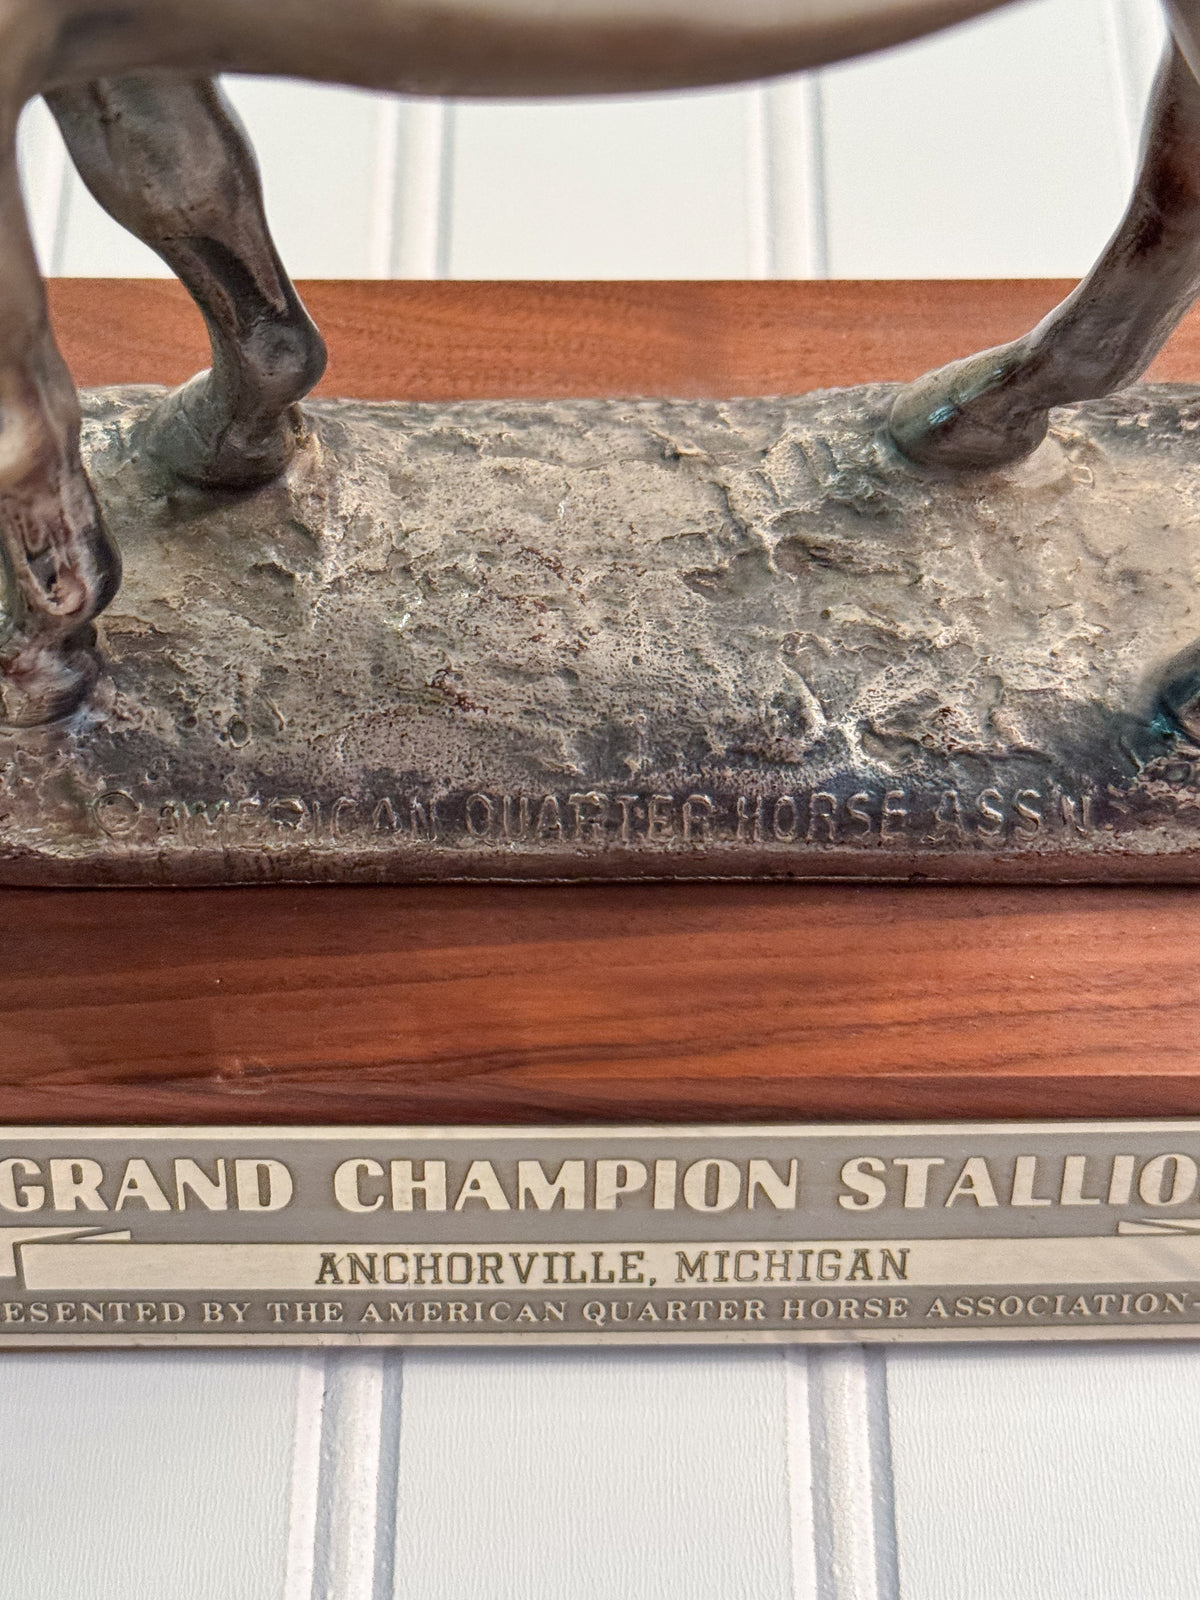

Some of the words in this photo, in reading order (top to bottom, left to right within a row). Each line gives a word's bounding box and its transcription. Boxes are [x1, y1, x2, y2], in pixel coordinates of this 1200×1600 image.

[736, 790, 906, 845] HORSE
[0, 1157, 293, 1213] GRAND
[333, 1158, 798, 1213] CHAMPION
[837, 1153, 1199, 1211] STALLIO
[315, 1250, 655, 1288] ANCHORVILLE,
[675, 1247, 911, 1283] MICHIGAN
[200, 1302, 252, 1325] BY
[266, 1302, 345, 1324] THE
[359, 1301, 566, 1324] AMERICAN
[582, 1300, 766, 1327] QUARTER
[780, 1297, 909, 1321] HORSE
